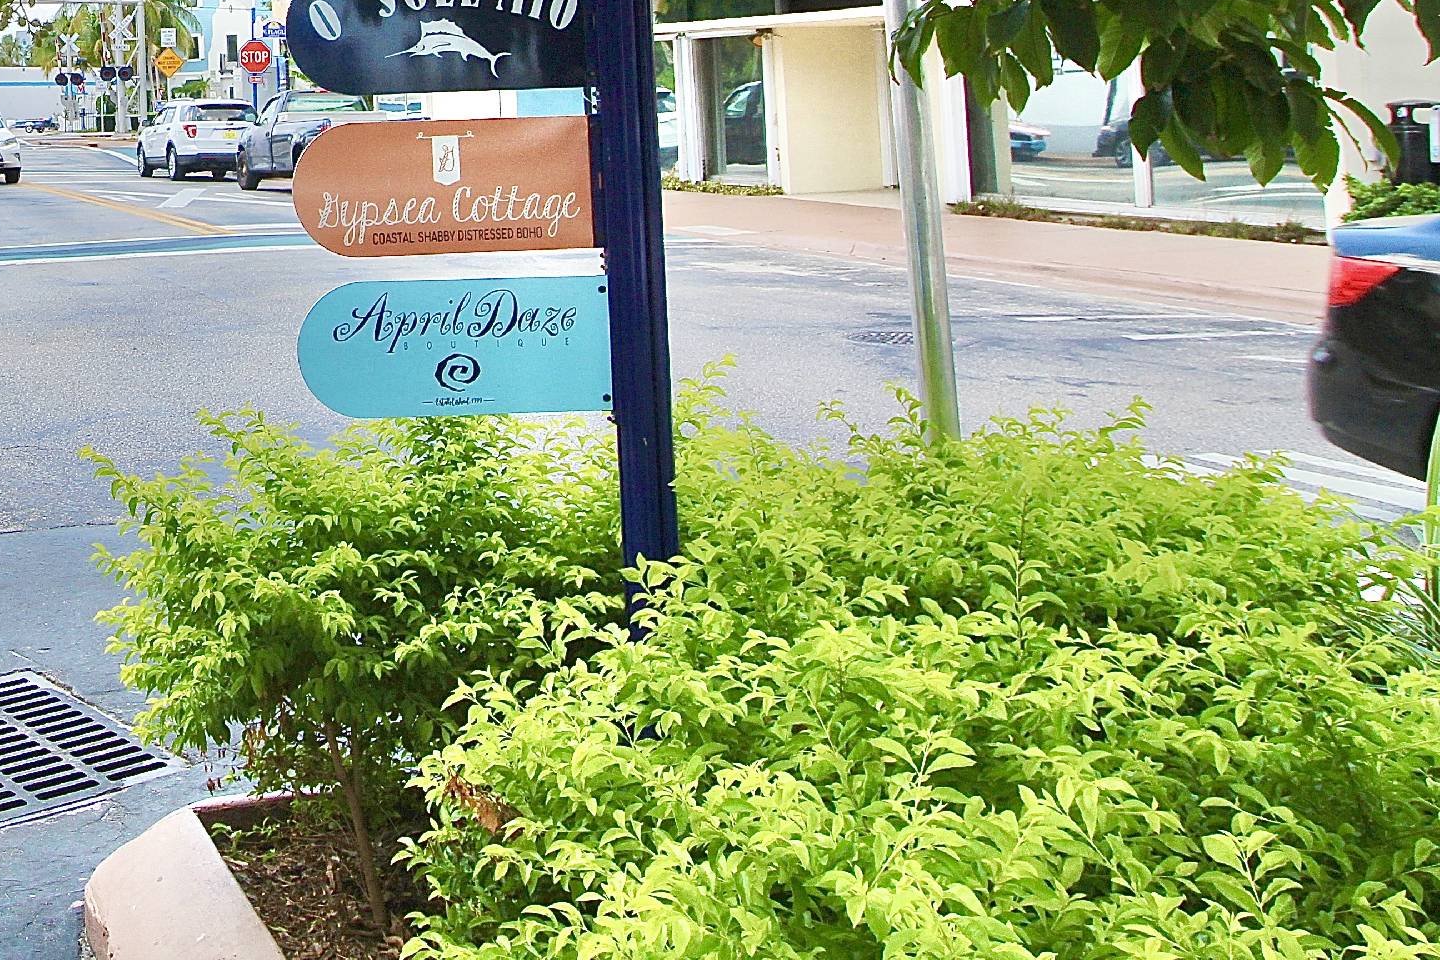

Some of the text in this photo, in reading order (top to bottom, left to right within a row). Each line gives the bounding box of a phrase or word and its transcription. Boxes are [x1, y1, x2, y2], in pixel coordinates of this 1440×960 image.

[241, 51, 269, 64] STOP
[318, 185, 581, 246] Gypsea Cottage
[372, 226, 543, 245] COASTAL SHABBY DISTRESSED BOHO
[333, 289, 577, 354] April Daze
[403, 338, 571, 351] BOUTIQUE
